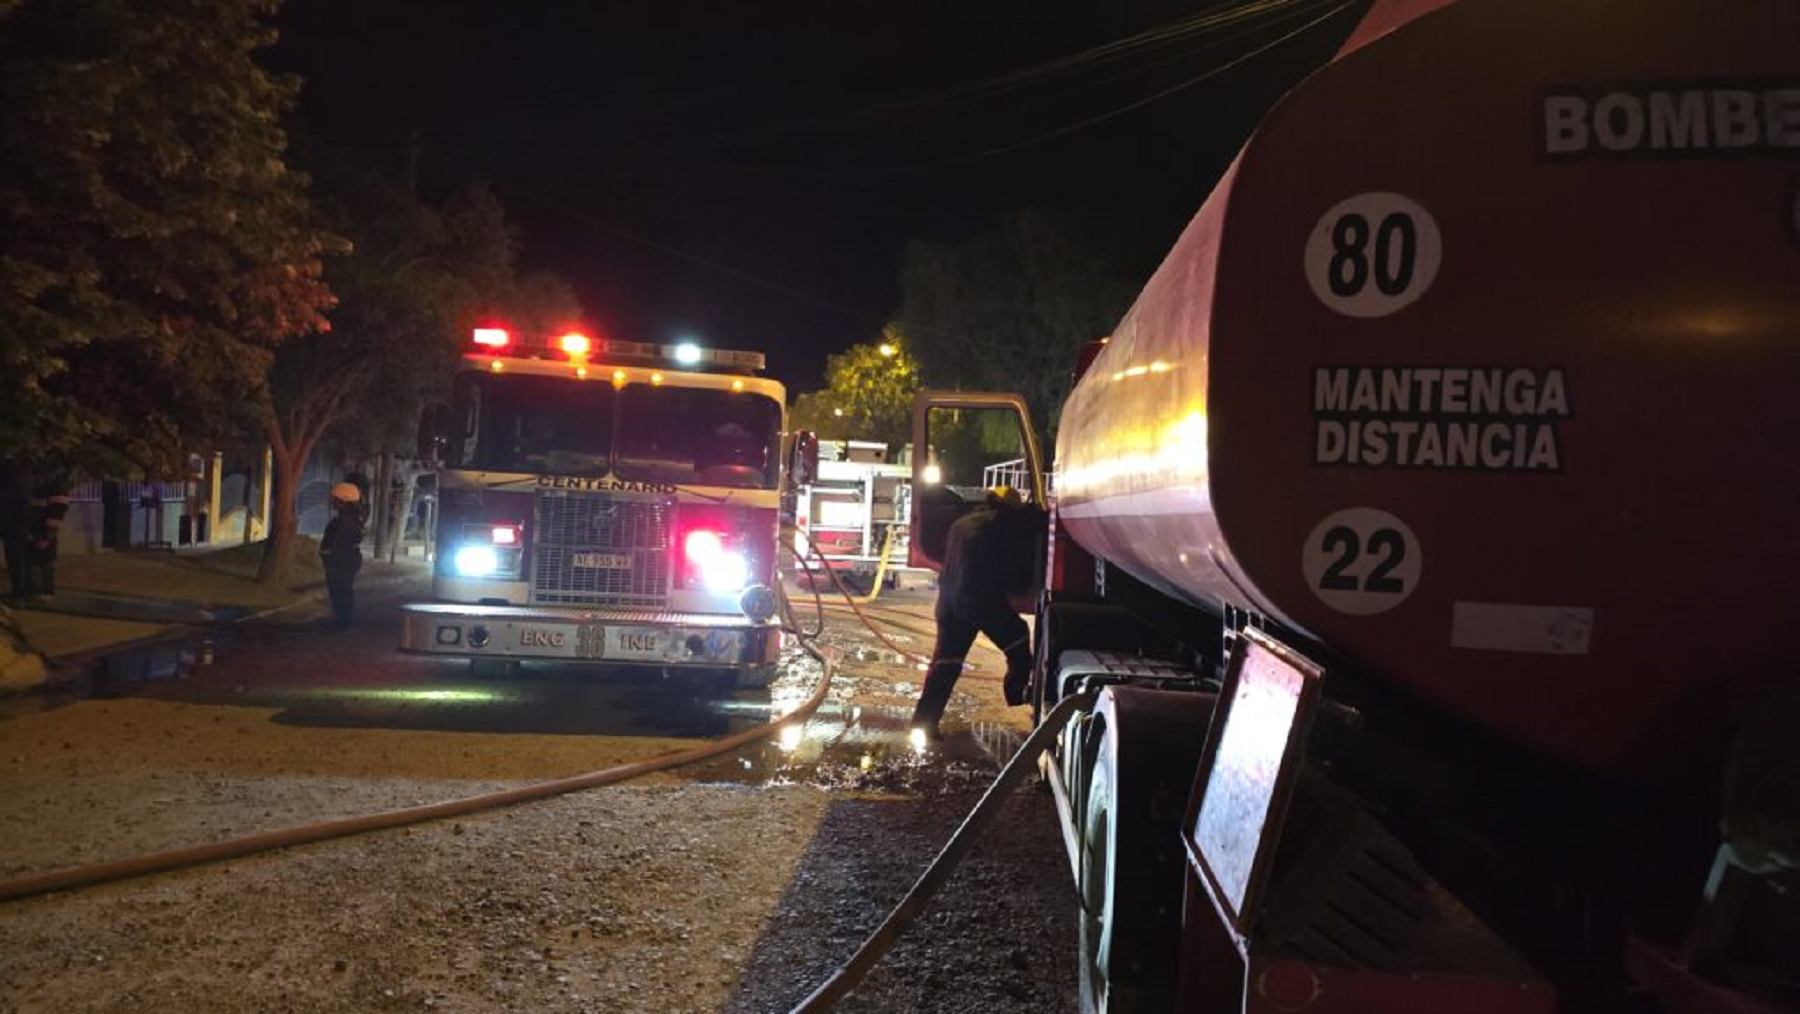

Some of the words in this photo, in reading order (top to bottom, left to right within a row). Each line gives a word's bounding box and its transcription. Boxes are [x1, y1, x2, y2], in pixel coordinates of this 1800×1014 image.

[1544, 89, 1800, 153] BOMBE
[1328, 211, 1416, 297] 80
[1314, 367, 1570, 416] MANTENGA
[1316, 419, 1559, 469] DISTANCIA
[537, 475, 677, 494] CENTENARIO
[1319, 525, 1405, 594] 22
[520, 629, 564, 648] ENG
[620, 633, 657, 651] INE
